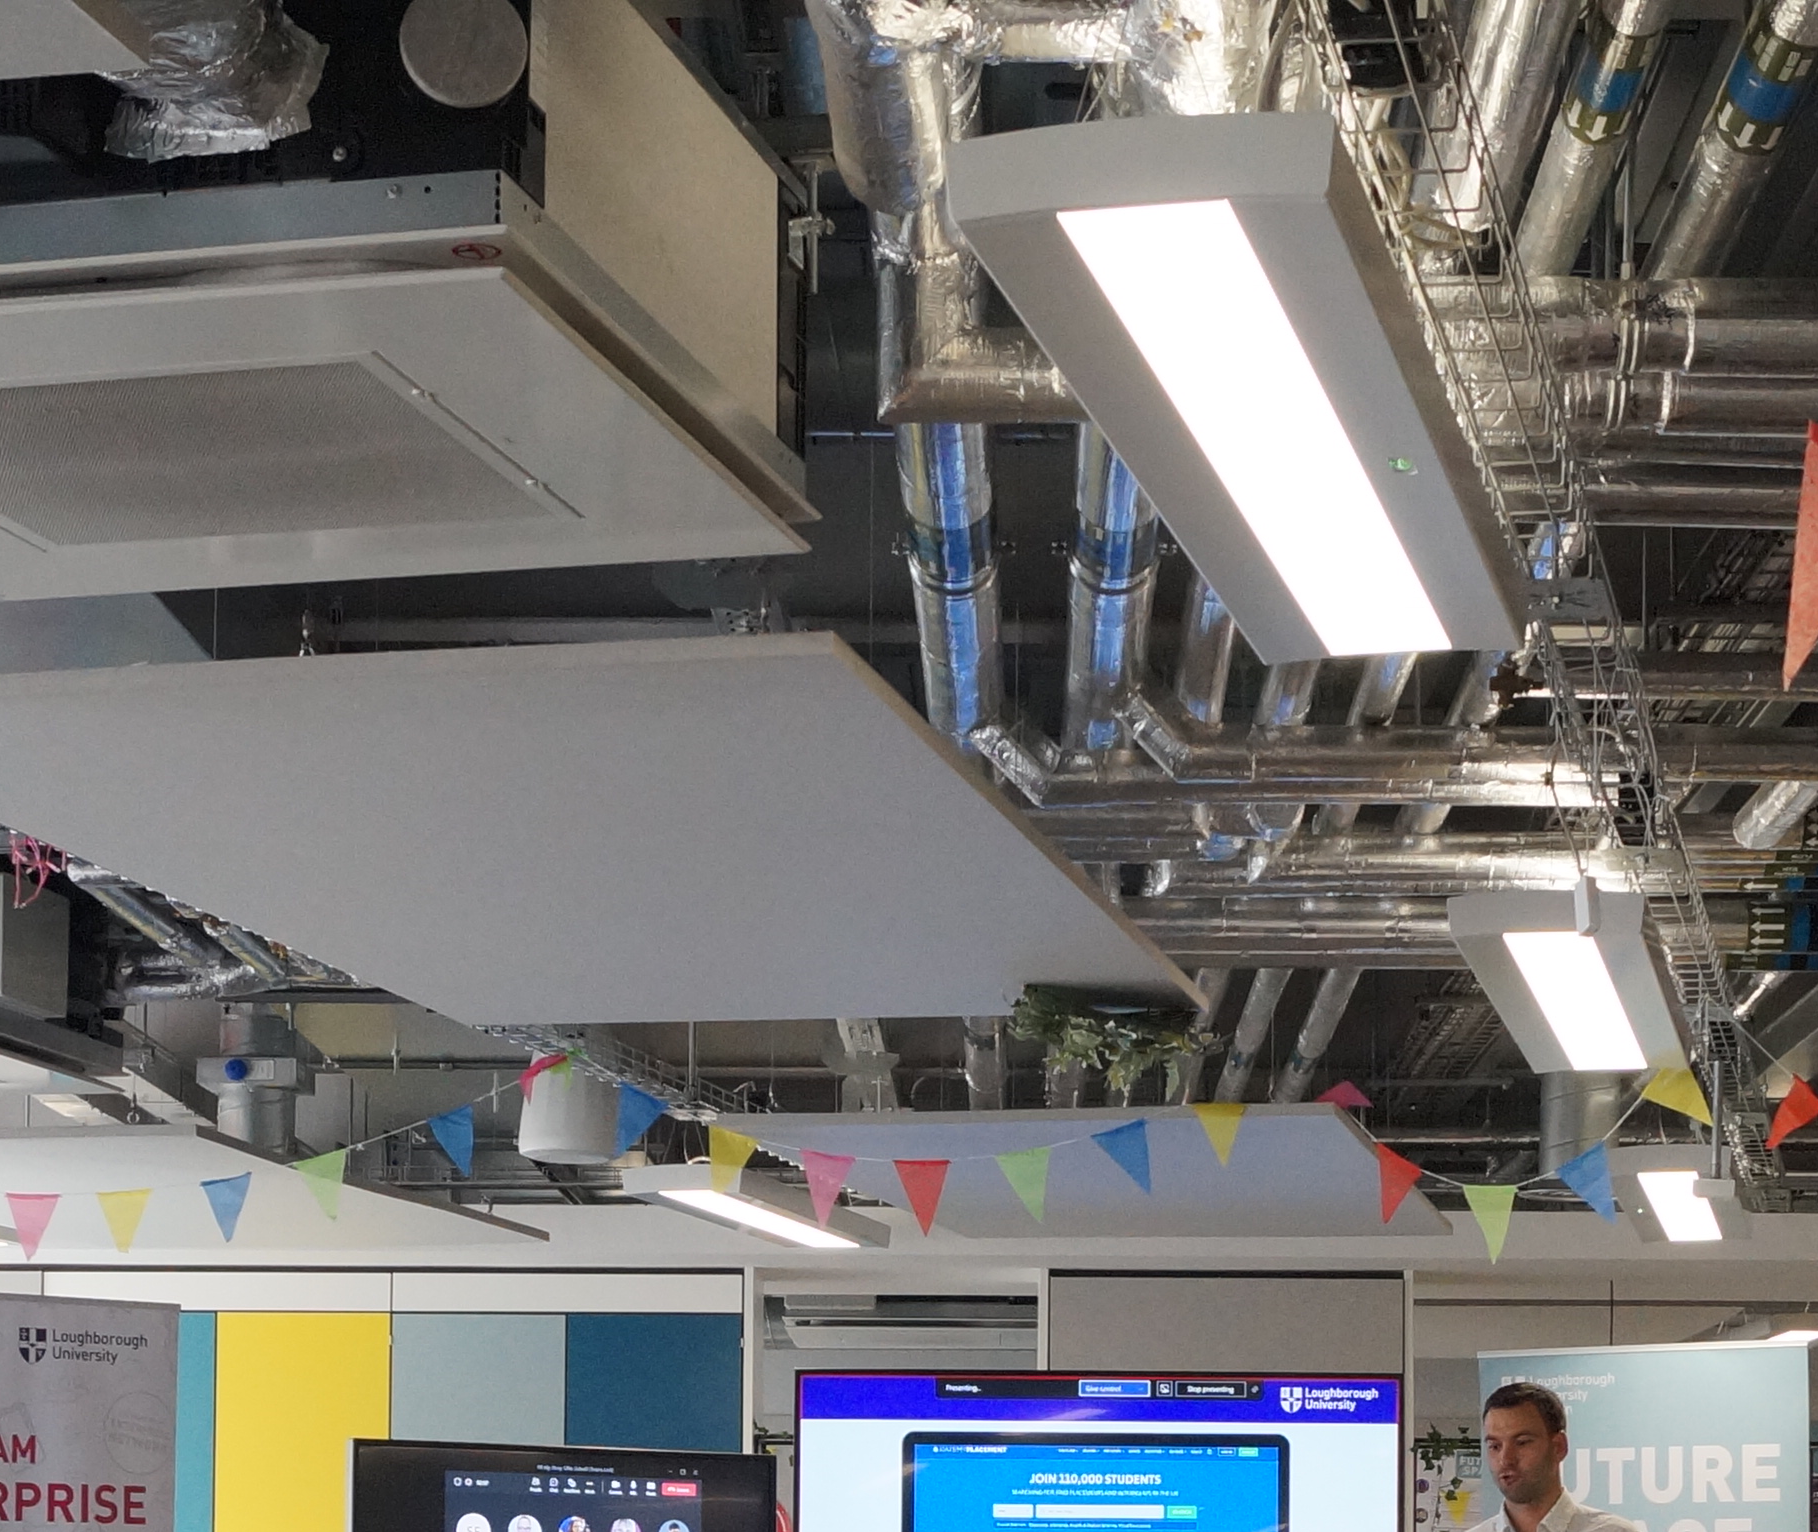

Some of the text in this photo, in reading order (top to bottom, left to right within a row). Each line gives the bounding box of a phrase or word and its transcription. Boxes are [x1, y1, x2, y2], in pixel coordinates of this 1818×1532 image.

[52, 1328, 148, 1350] Loughborough
[52, 1348, 119, 1366] University
[1304, 1386, 1379, 1402] Loughborough
[1304, 1398, 1357, 1412] University
[1029, 1473, 1162, 1486] JOIN 110,000 STUDENTS
[1561, 1443, 1781, 1504] UTURE
